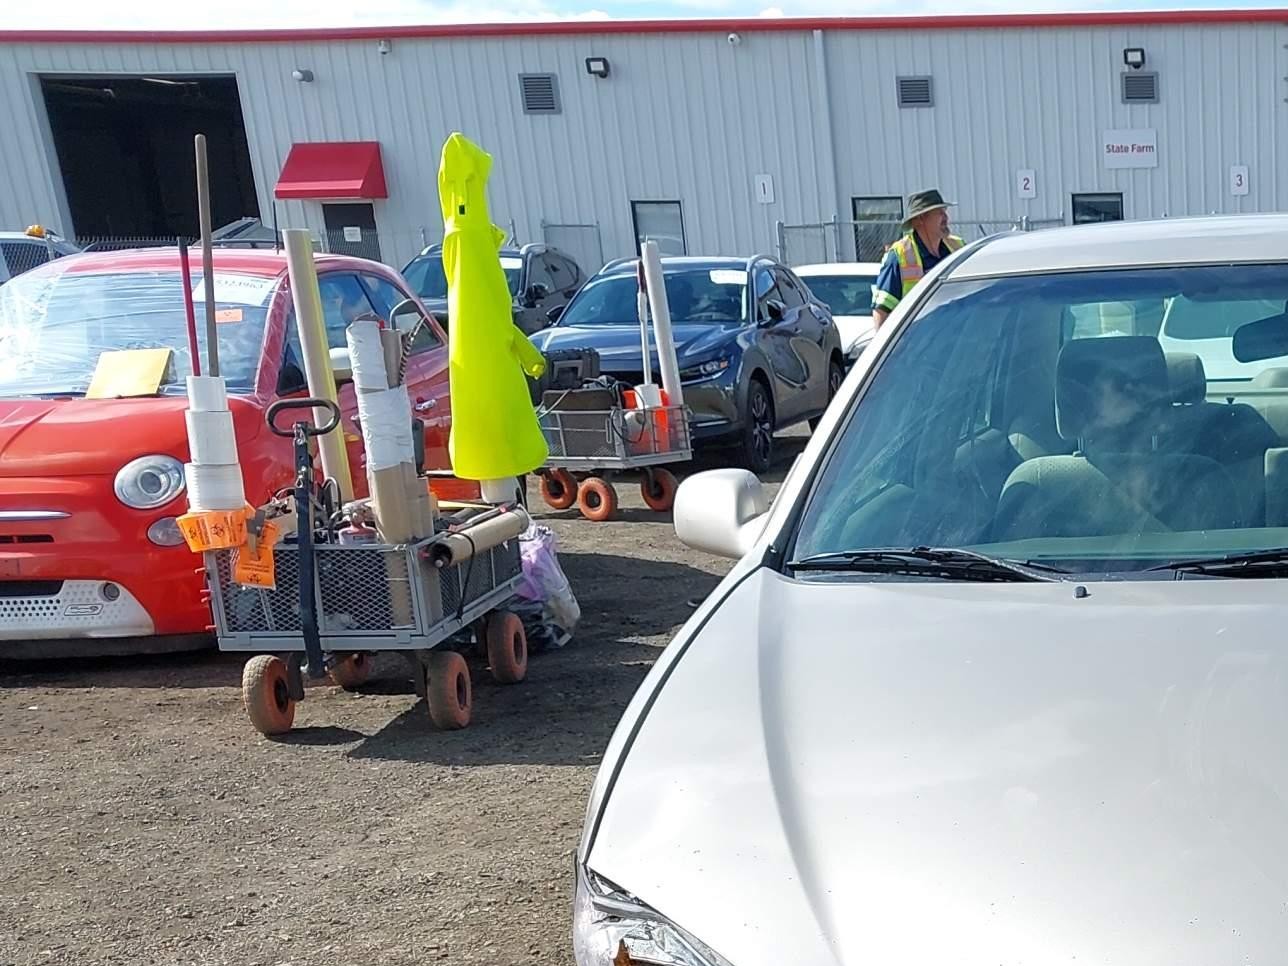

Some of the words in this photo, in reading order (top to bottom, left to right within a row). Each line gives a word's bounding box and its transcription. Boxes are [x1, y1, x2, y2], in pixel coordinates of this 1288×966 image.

[1105, 143, 1129, 153] State
[1131, 143, 1155, 153] Farm
[1023, 177, 1031, 191] 2
[1236, 173, 1243, 187] 3
[761, 181, 767, 195] 1
